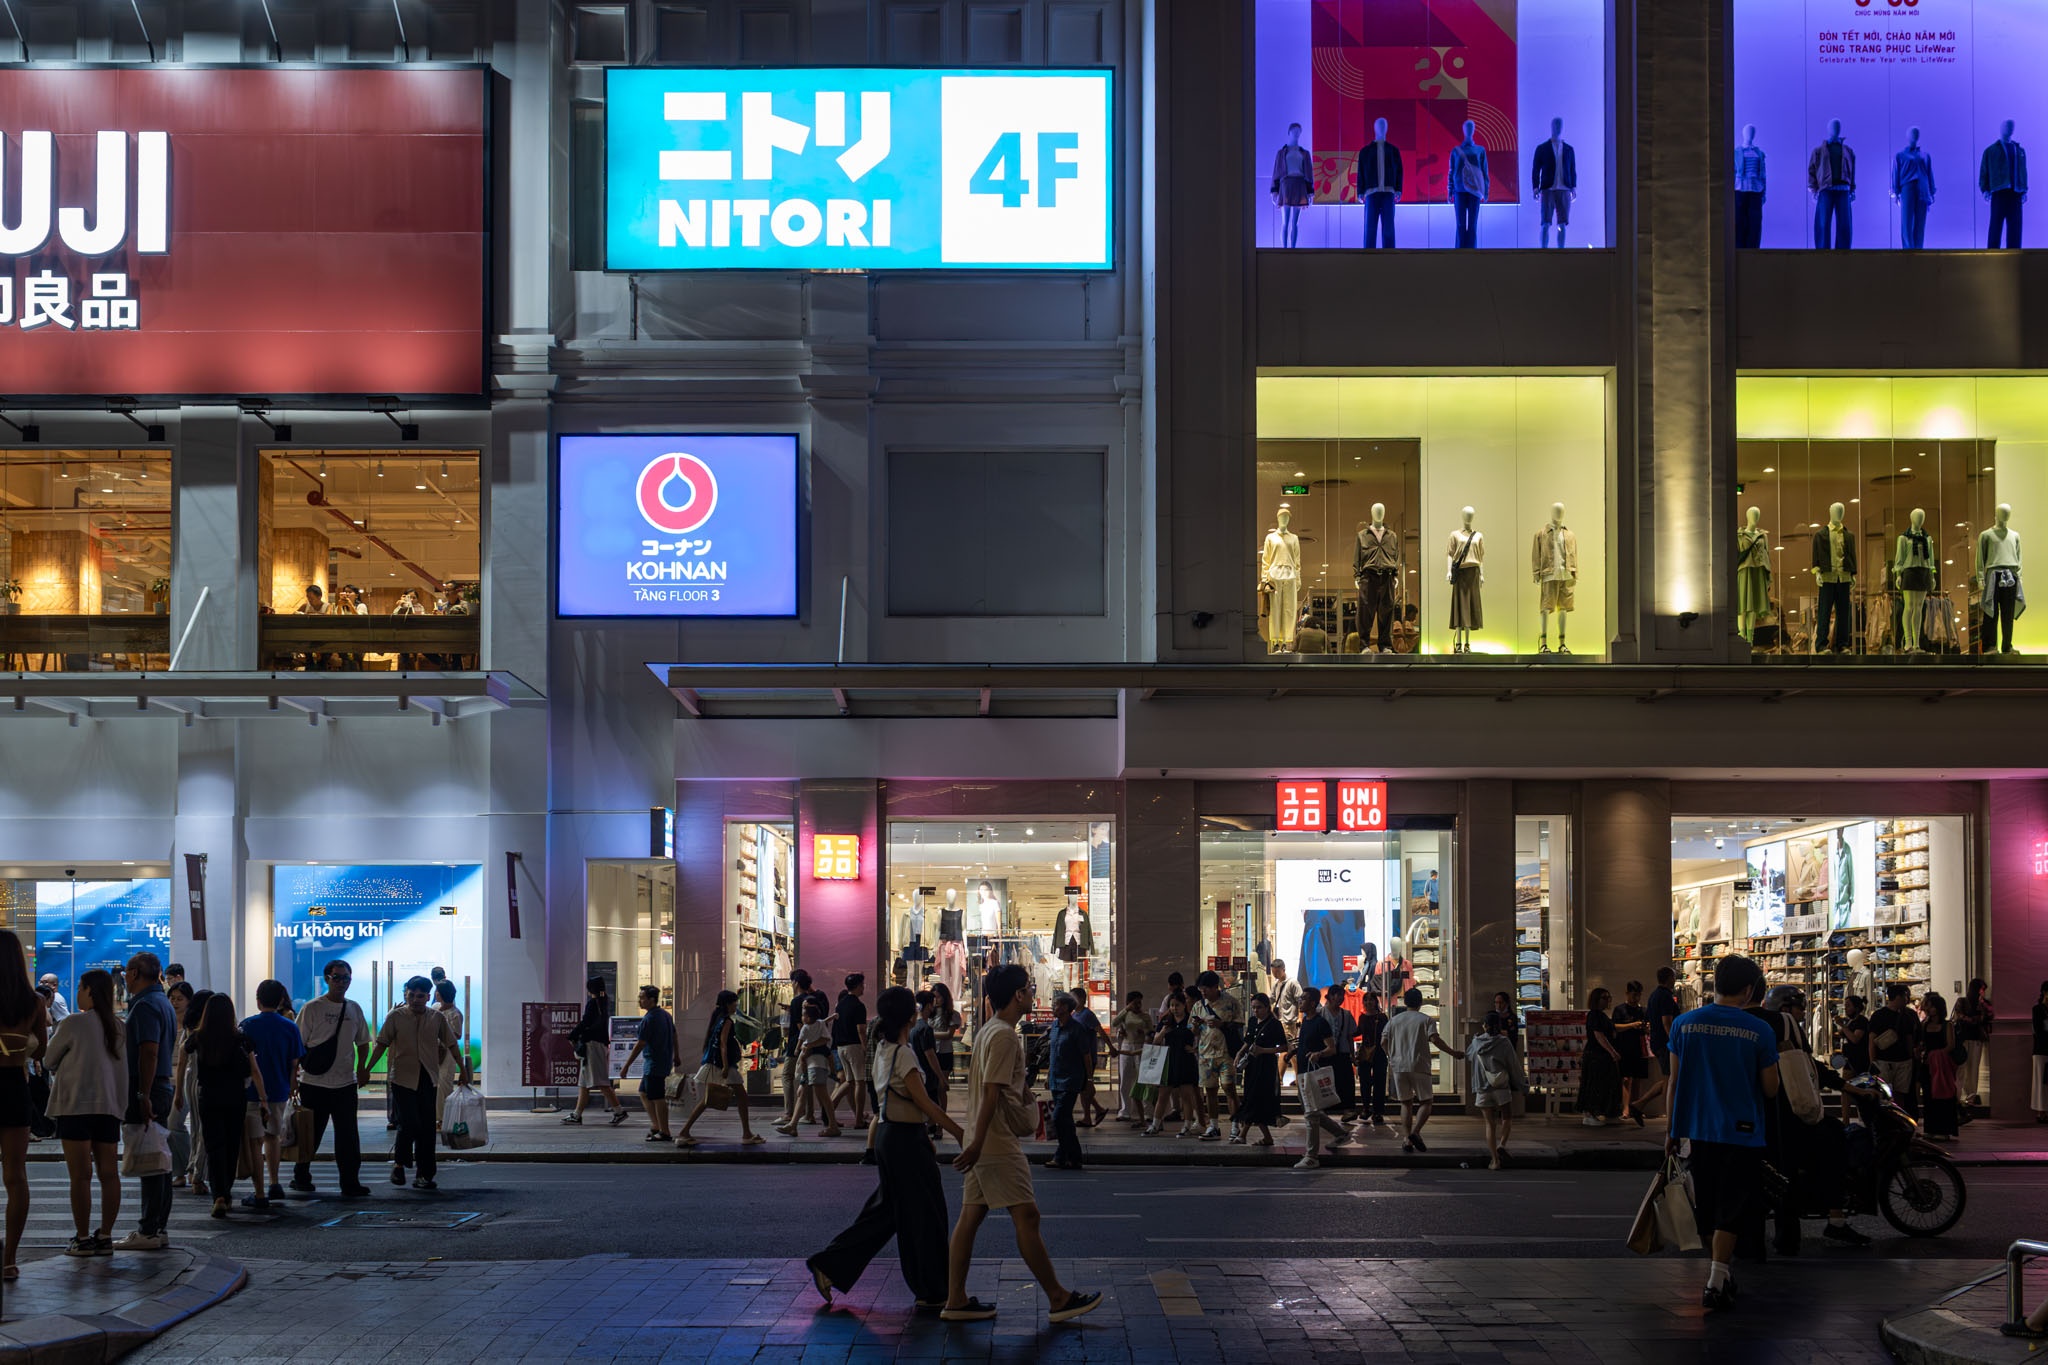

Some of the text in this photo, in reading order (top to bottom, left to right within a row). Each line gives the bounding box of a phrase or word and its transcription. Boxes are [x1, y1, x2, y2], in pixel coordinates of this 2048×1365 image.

[1842, 29, 1860, 41] TẾT
[1886, 30, 1911, 41] CHÀO
[1915, 30, 1936, 41] NĂM
[1939, 30, 1956, 41] MỚI
[1820, 43, 1956, 56] CÙNG TRANG PHỤC LifeWear
[1820, 56, 1856, 64] Celebrate
[1901, 56, 1917, 64] with
[1921, 56, 1956, 64] LifeWear
[659, 91, 891, 183] ニトリ
[969, 132, 1079, 208] 4F
[658, 198, 891, 247] NITORI
[642, 539, 712, 556] コーナン
[626, 561, 727, 580] KOHNAN
[633, 587, 720, 601] TẦNG FLOOR 3
[302, 922, 354, 941] không
[358, 922, 384, 937] khí
[551, 1011, 578, 1023] MUJI
[1681, 1023, 1760, 1042] WEARETHEPRIVATE
[555, 1066, 578, 1074] 10:00
[554, 1076, 578, 1084] 22:00
